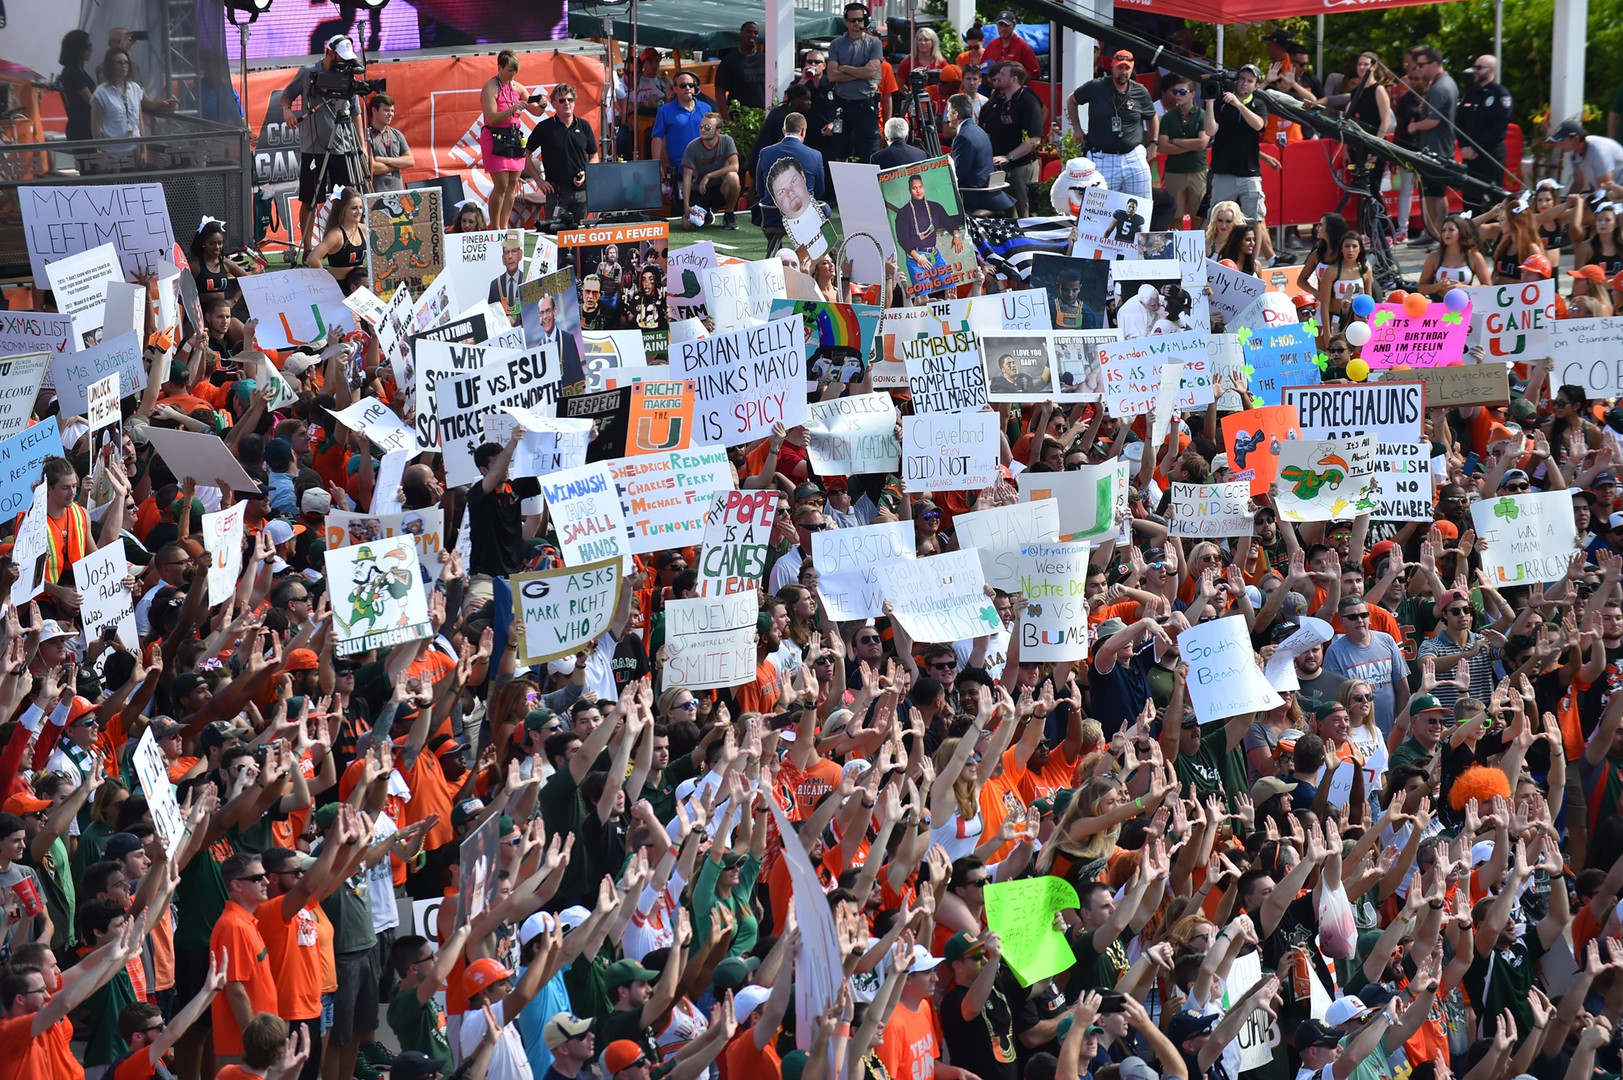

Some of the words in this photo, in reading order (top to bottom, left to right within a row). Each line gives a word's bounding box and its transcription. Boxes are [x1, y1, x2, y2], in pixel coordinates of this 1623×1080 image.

[879, 168, 906, 182] SOUTH
[906, 162, 928, 176] BEND
[928, 158, 951, 171] OVER
[31, 189, 79, 219] MY
[84, 186, 163, 217] WIFE
[1088, 192, 1109, 200] NOTRE
[1084, 208, 1112, 217] MAJORS
[31, 222, 89, 255] LEFT
[93, 219, 137, 251] ME
[146, 217, 170, 245] 4
[428, 192, 440, 265] SWAGGER
[462, 233, 508, 245] FINEBAUM
[563, 232, 586, 245] I'VE
[592, 229, 614, 242] GOT
[615, 229, 624, 241] A
[626, 226, 664, 239] FEVER!
[1081, 233, 1098, 242] FAKE
[462, 244, 487, 255] LOVES
[462, 253, 486, 263] MIAMI
[1175, 231, 1204, 272] Kelly
[905, 277, 940, 295] GOING
[941, 273, 963, 290] GET
[964, 269, 977, 283] IT
[914, 264, 951, 282] CAUSE
[951, 262, 963, 275] U
[710, 272, 760, 299] BRIAN
[1234, 277, 1258, 297] Uses
[1497, 284, 1541, 307] GO
[264, 291, 298, 305] About
[677, 303, 709, 320] FAM
[931, 304, 951, 317] THE
[43, 320, 71, 337] LIST
[450, 321, 474, 338] THING
[1422, 320, 1438, 328] MY
[1568, 324, 1596, 332] want
[682, 334, 740, 371] BRIAN
[749, 320, 796, 359] KELLY
[902, 331, 978, 360] WIMBUSH
[1373, 343, 1391, 352] AND
[1412, 342, 1443, 351] FEELIN
[1404, 331, 1449, 341] BIRTHDAY
[449, 346, 486, 369] WHY
[922, 355, 957, 375] ONLY
[1099, 343, 1148, 365] Brandon
[1281, 352, 1298, 365] PICK
[1380, 351, 1437, 364] LUCKY
[66, 365, 89, 382] Ms.
[454, 374, 482, 409] UF
[508, 351, 547, 389] FSU
[753, 350, 799, 388] MAYO
[872, 375, 896, 383] GOING
[910, 366, 984, 395] COMPLETES
[1258, 379, 1275, 391] THE
[567, 392, 621, 416] RESPECT
[913, 393, 950, 414] HAIL
[950, 386, 986, 411] MARYS
[1440, 386, 1494, 400] Lopez
[91, 402, 104, 422] THE
[654, 412, 668, 420] THE
[702, 412, 723, 441] IS
[734, 391, 786, 433] SPICY
[1287, 388, 1419, 428] LEPRECHAUNS
[20, 425, 55, 452] KELLY
[636, 417, 683, 450] U
[913, 418, 985, 450] Cleveland
[810, 437, 851, 462] BORN
[1351, 451, 1370, 462] About
[607, 461, 670, 480] SHELDRICK
[669, 452, 728, 470] REDWINE
[908, 456, 936, 480] DID
[939, 455, 971, 476] NOT
[1350, 466, 1365, 475] The
[543, 473, 607, 505] WIMBUSH
[627, 478, 675, 496] CHARLES
[676, 472, 714, 488] PERRY
[1173, 484, 1196, 498] MY
[1199, 483, 1220, 498] EX
[1396, 481, 1419, 493] NO
[631, 497, 682, 515] MICHAEL
[707, 495, 727, 527] THE
[723, 490, 780, 527] POPE
[1172, 501, 1194, 517] TO
[1198, 501, 1221, 516] ND
[563, 514, 616, 545] SMALL
[635, 519, 702, 538] TURNOVER
[723, 525, 738, 543] IS
[743, 525, 755, 543] A
[990, 505, 1052, 551] HAVE
[1169, 518, 1198, 534] PICS
[578, 536, 619, 564] HANDS
[822, 530, 912, 574] BARSTOOL
[1510, 541, 1541, 555] MIAMI
[81, 559, 116, 591] Josh
[862, 567, 878, 584] VS
[1036, 560, 1073, 575] Week
[566, 567, 614, 594] ASKS
[1021, 575, 1065, 599] Notre
[821, 592, 849, 614] THE
[901, 588, 988, 615] #NoShaveNovember
[1052, 602, 1075, 620] VS
[525, 603, 560, 624] MARK
[673, 607, 696, 634] I'M
[697, 598, 758, 631] JEWISH
[553, 613, 604, 644] WHO?
[1023, 623, 1086, 648] BUMS
[336, 638, 366, 657] SILLY
[365, 623, 434, 649] LEPRECHAUN
[1186, 639, 1236, 662] South
[669, 652, 730, 685] SMITE
[734, 647, 755, 678] ME
[1197, 667, 1241, 685] Beach
